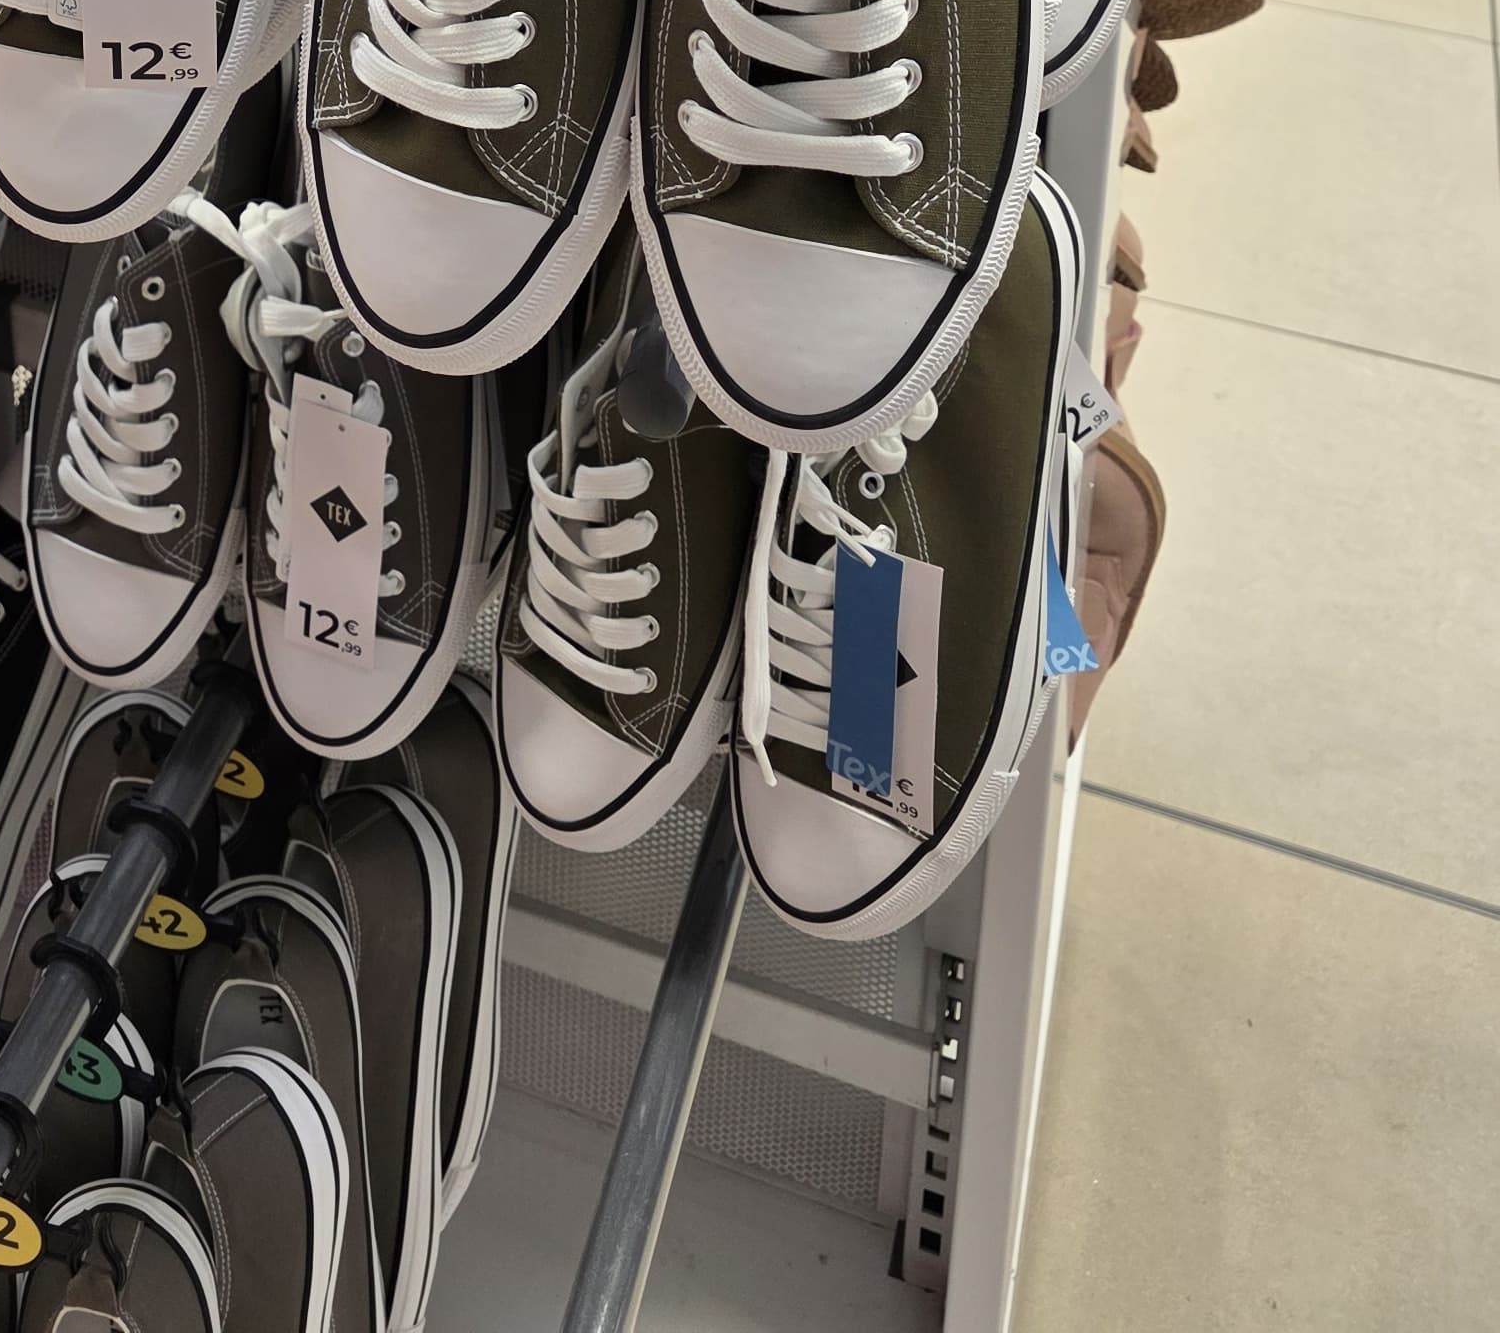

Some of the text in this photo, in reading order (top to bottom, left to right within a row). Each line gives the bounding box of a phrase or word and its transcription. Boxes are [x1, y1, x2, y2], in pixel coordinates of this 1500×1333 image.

[169, 41, 192, 60] €
[1080, 393, 1096, 409] €
[324, 500, 353, 528] TEX
[344, 619, 360, 638] €
[829, 738, 891, 797] Tex
[896, 778, 914, 797] €
[260, 995, 284, 1025] TEX
